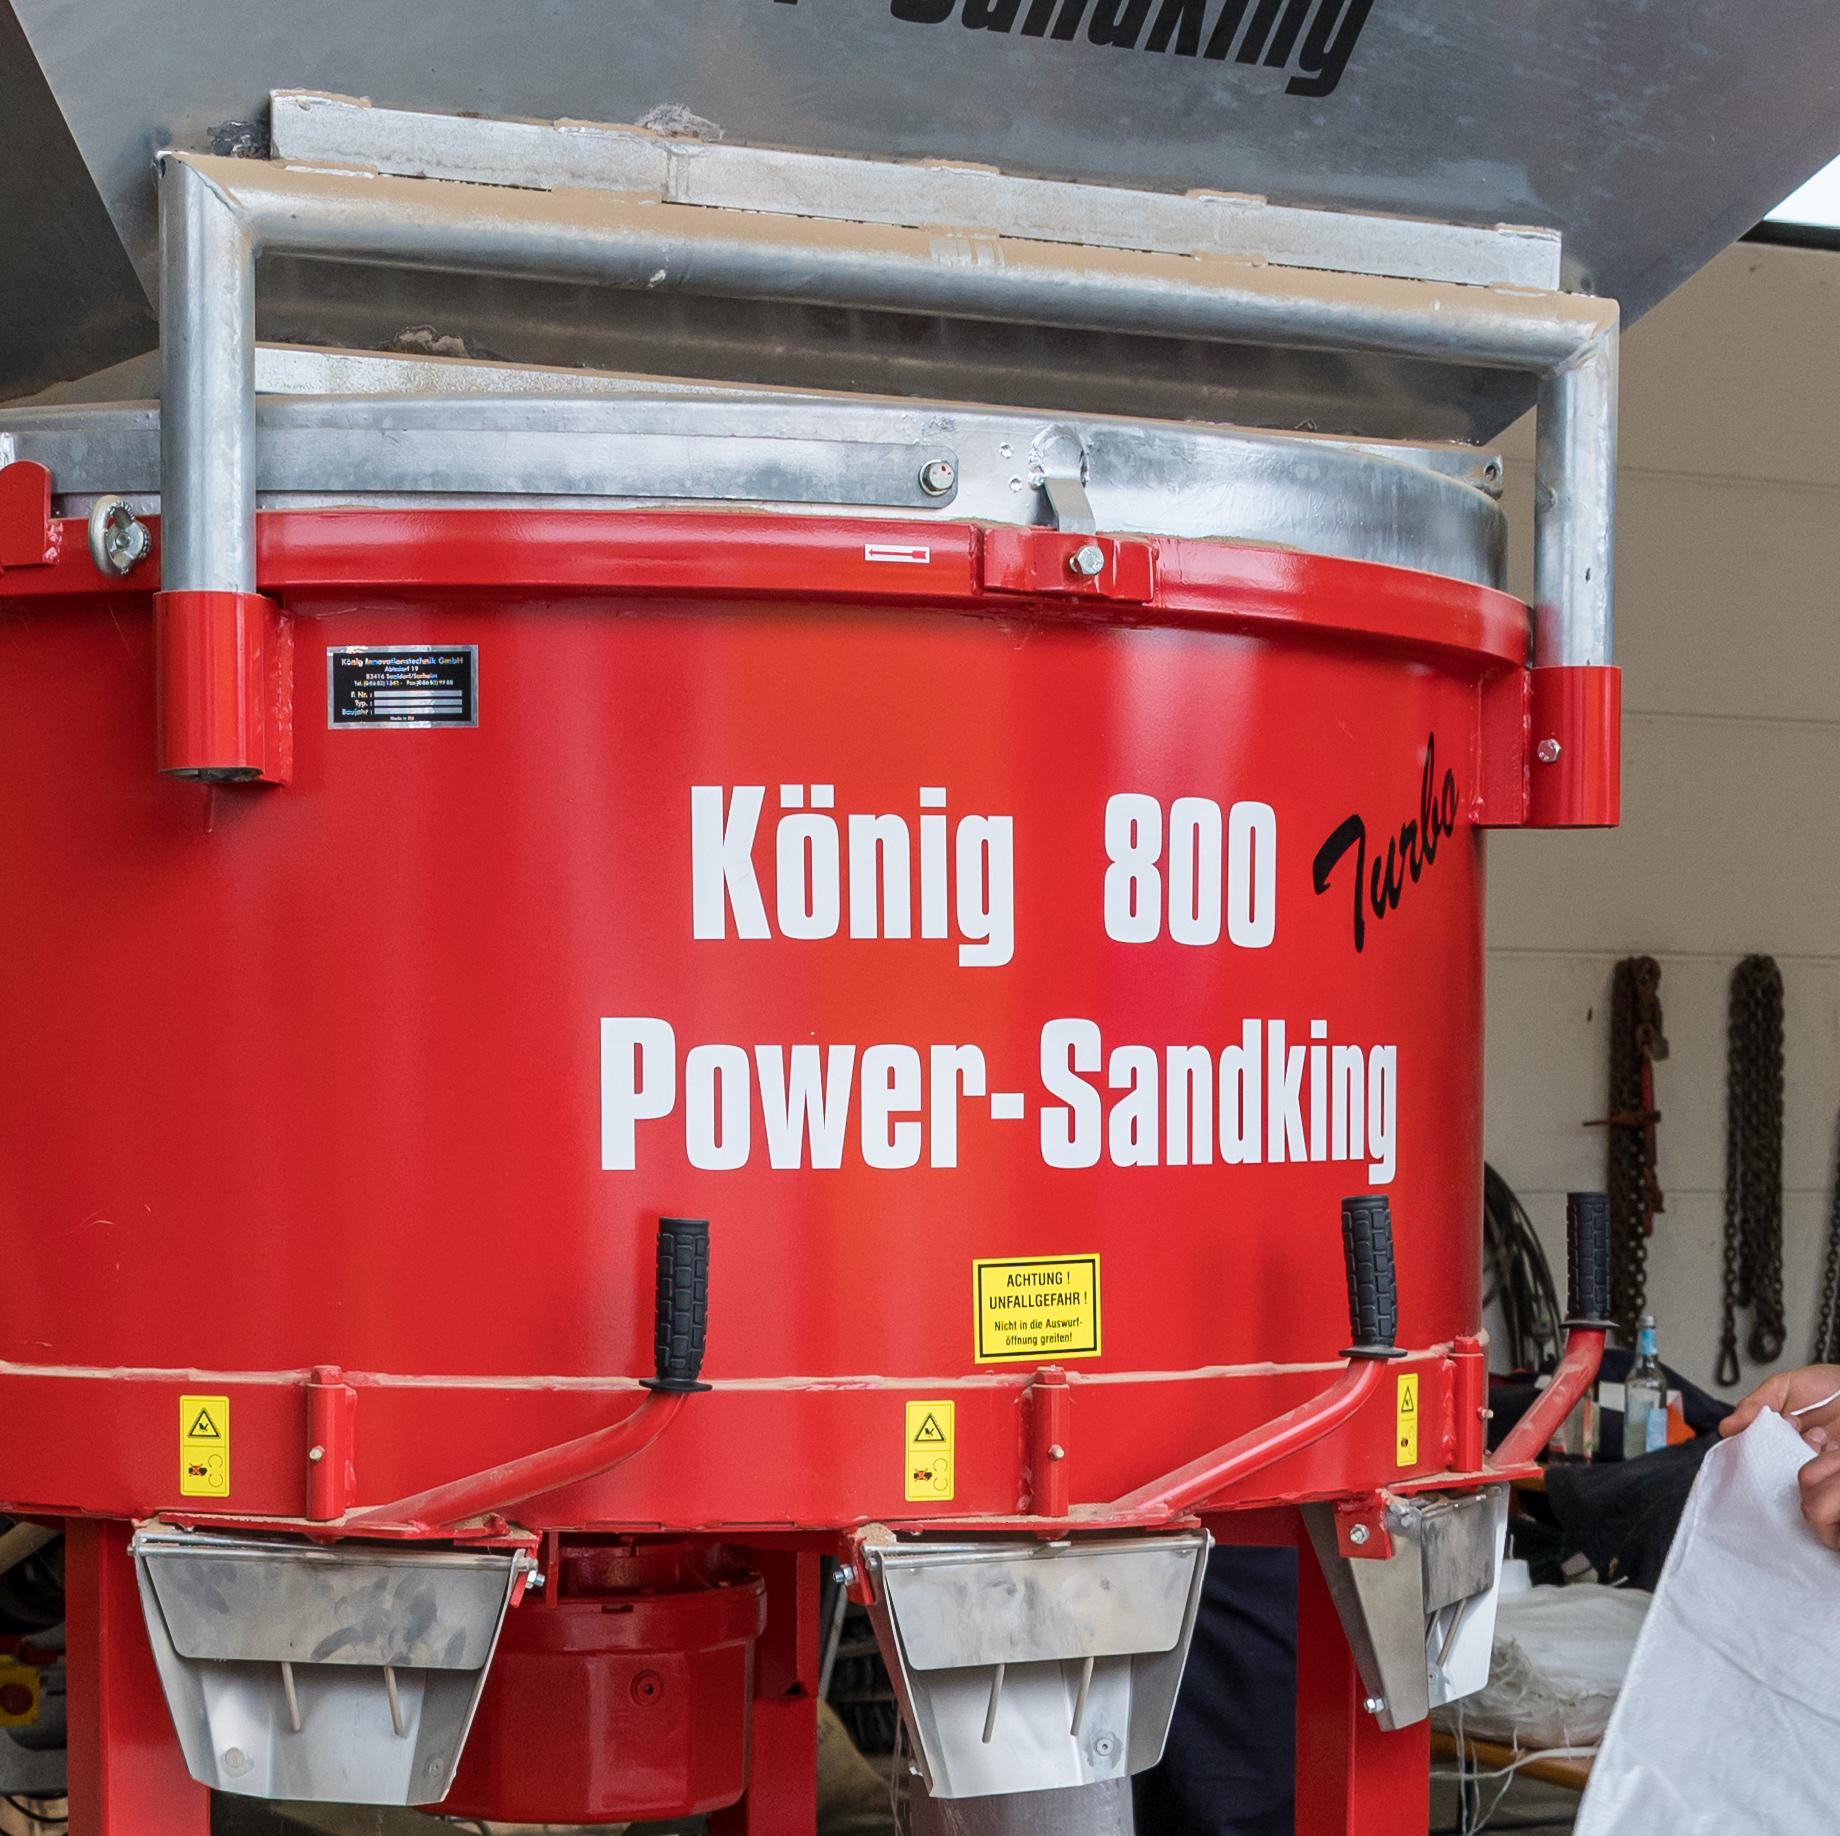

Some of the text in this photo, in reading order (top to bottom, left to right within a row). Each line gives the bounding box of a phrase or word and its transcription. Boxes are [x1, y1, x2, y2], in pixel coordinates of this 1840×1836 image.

[438, 656, 464, 665] GmbH
[691, 731, 1459, 968] König 800 Turbo
[600, 1017, 1398, 1185] Power-Sandking
[1006, 1271, 1063, 1287] ACHTUNG
[989, 1291, 1080, 1309] UNFALLGEFAHR
[994, 1317, 1084, 1331] Nicht in die Auswurf-
[1005, 1332, 1073, 1347] öffnung greifen!
